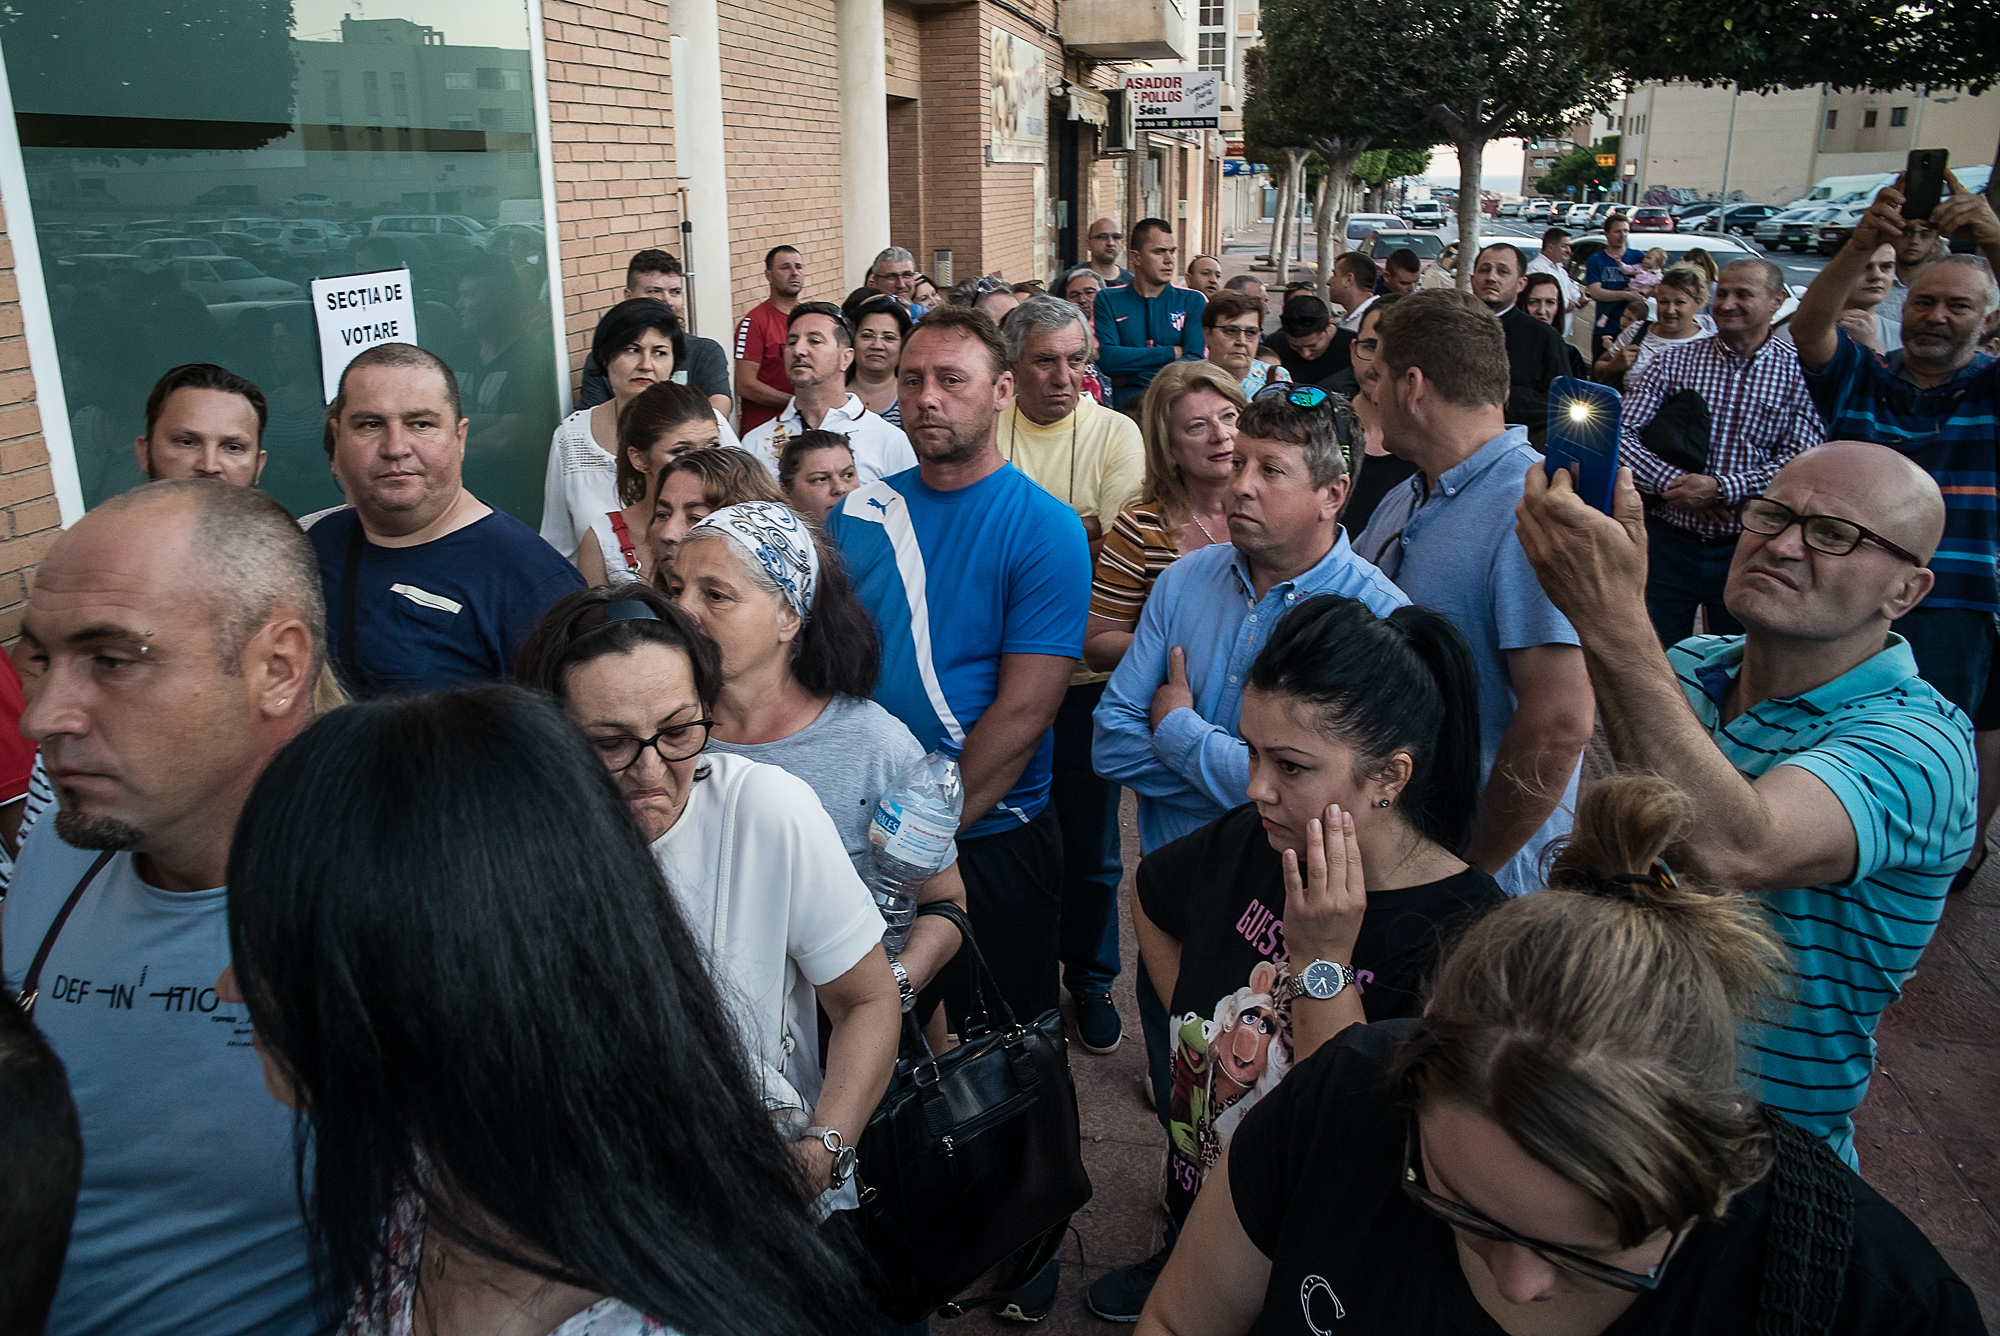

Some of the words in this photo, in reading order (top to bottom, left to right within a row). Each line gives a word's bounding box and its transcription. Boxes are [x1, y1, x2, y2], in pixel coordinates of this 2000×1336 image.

[1125, 77, 1182, 90] ASADOR
[1141, 90, 1182, 103] POLLOS
[384, 284, 402, 302] DE
[341, 320, 399, 346] VOTARE
[1236, 899, 1289, 962] GUESS
